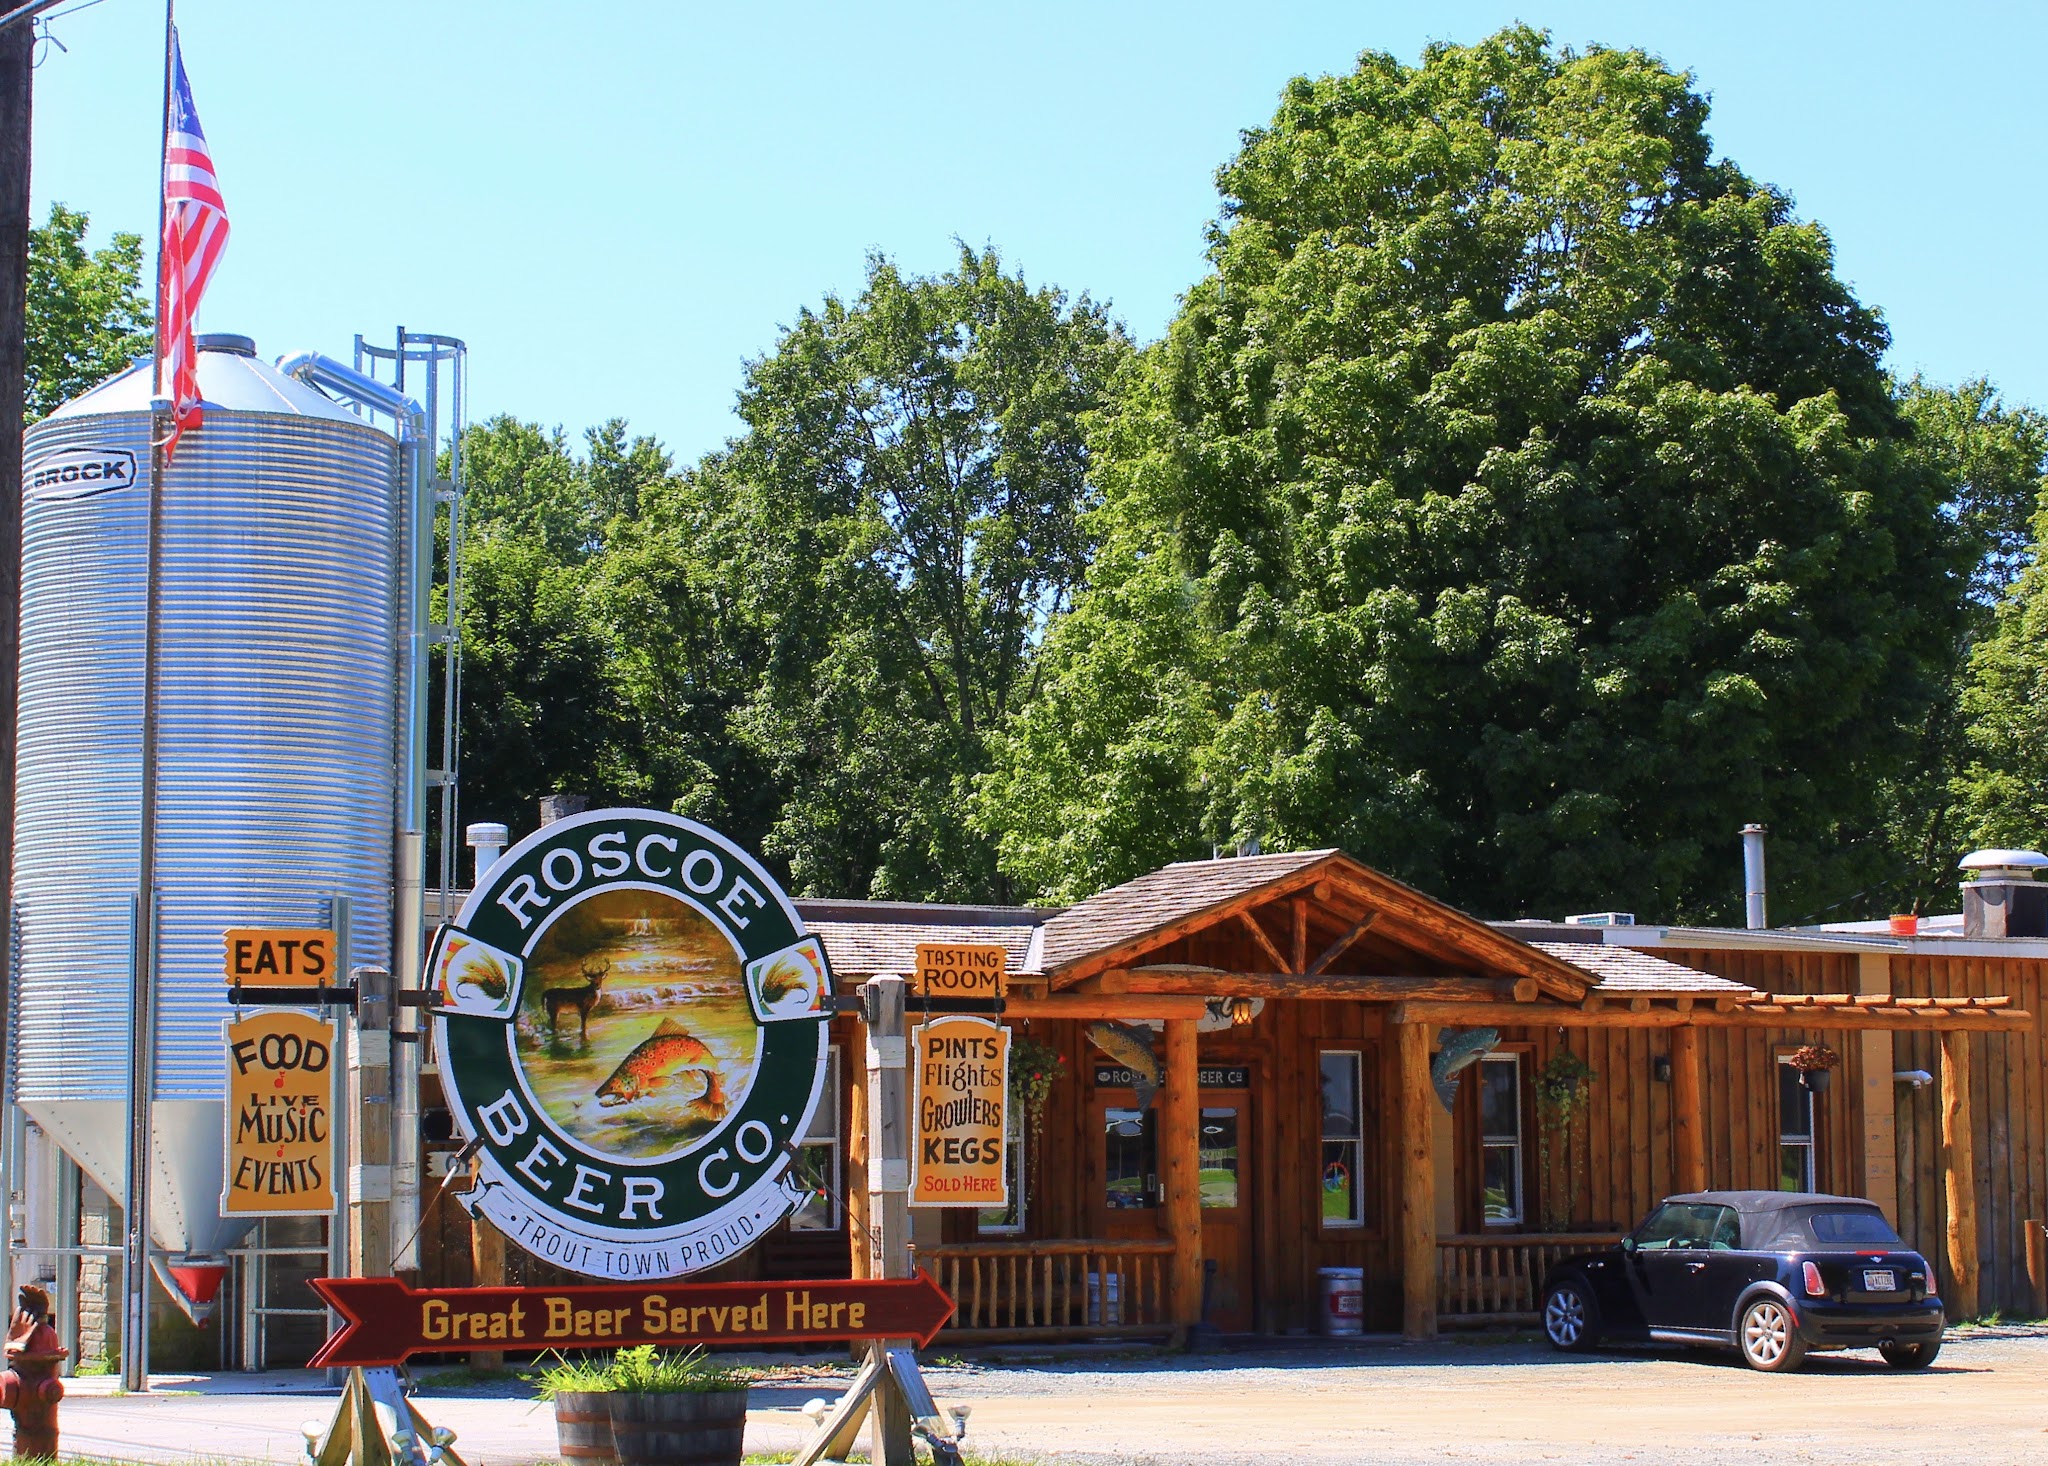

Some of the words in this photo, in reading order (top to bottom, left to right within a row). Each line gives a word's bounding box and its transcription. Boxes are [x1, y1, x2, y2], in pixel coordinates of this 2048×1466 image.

[34, 460, 126, 488] BROCK
[496, 831, 767, 930] ROSCOE
[235, 940, 325, 975] EATS
[923, 950, 999, 968] TASTING
[923, 969, 1000, 990] ROOM
[231, 1033, 329, 1075] FOOD
[928, 1037, 998, 1059] PINTS
[925, 1061, 1001, 1091] Flights
[251, 1095, 319, 1107] LIVE
[476, 1088, 666, 1220] BEER
[923, 1137, 1001, 1165] KEGS
[233, 1156, 322, 1195] EVENTS
[517, 1216, 592, 1267] TROUT
[604, 1251, 670, 1275] TOWN
[681, 1215, 755, 1267] PROUD
[421, 1299, 526, 1340] Great
[544, 1297, 631, 1338] Beer
[642, 1293, 768, 1336] Served
[785, 1291, 866, 1331] Here
